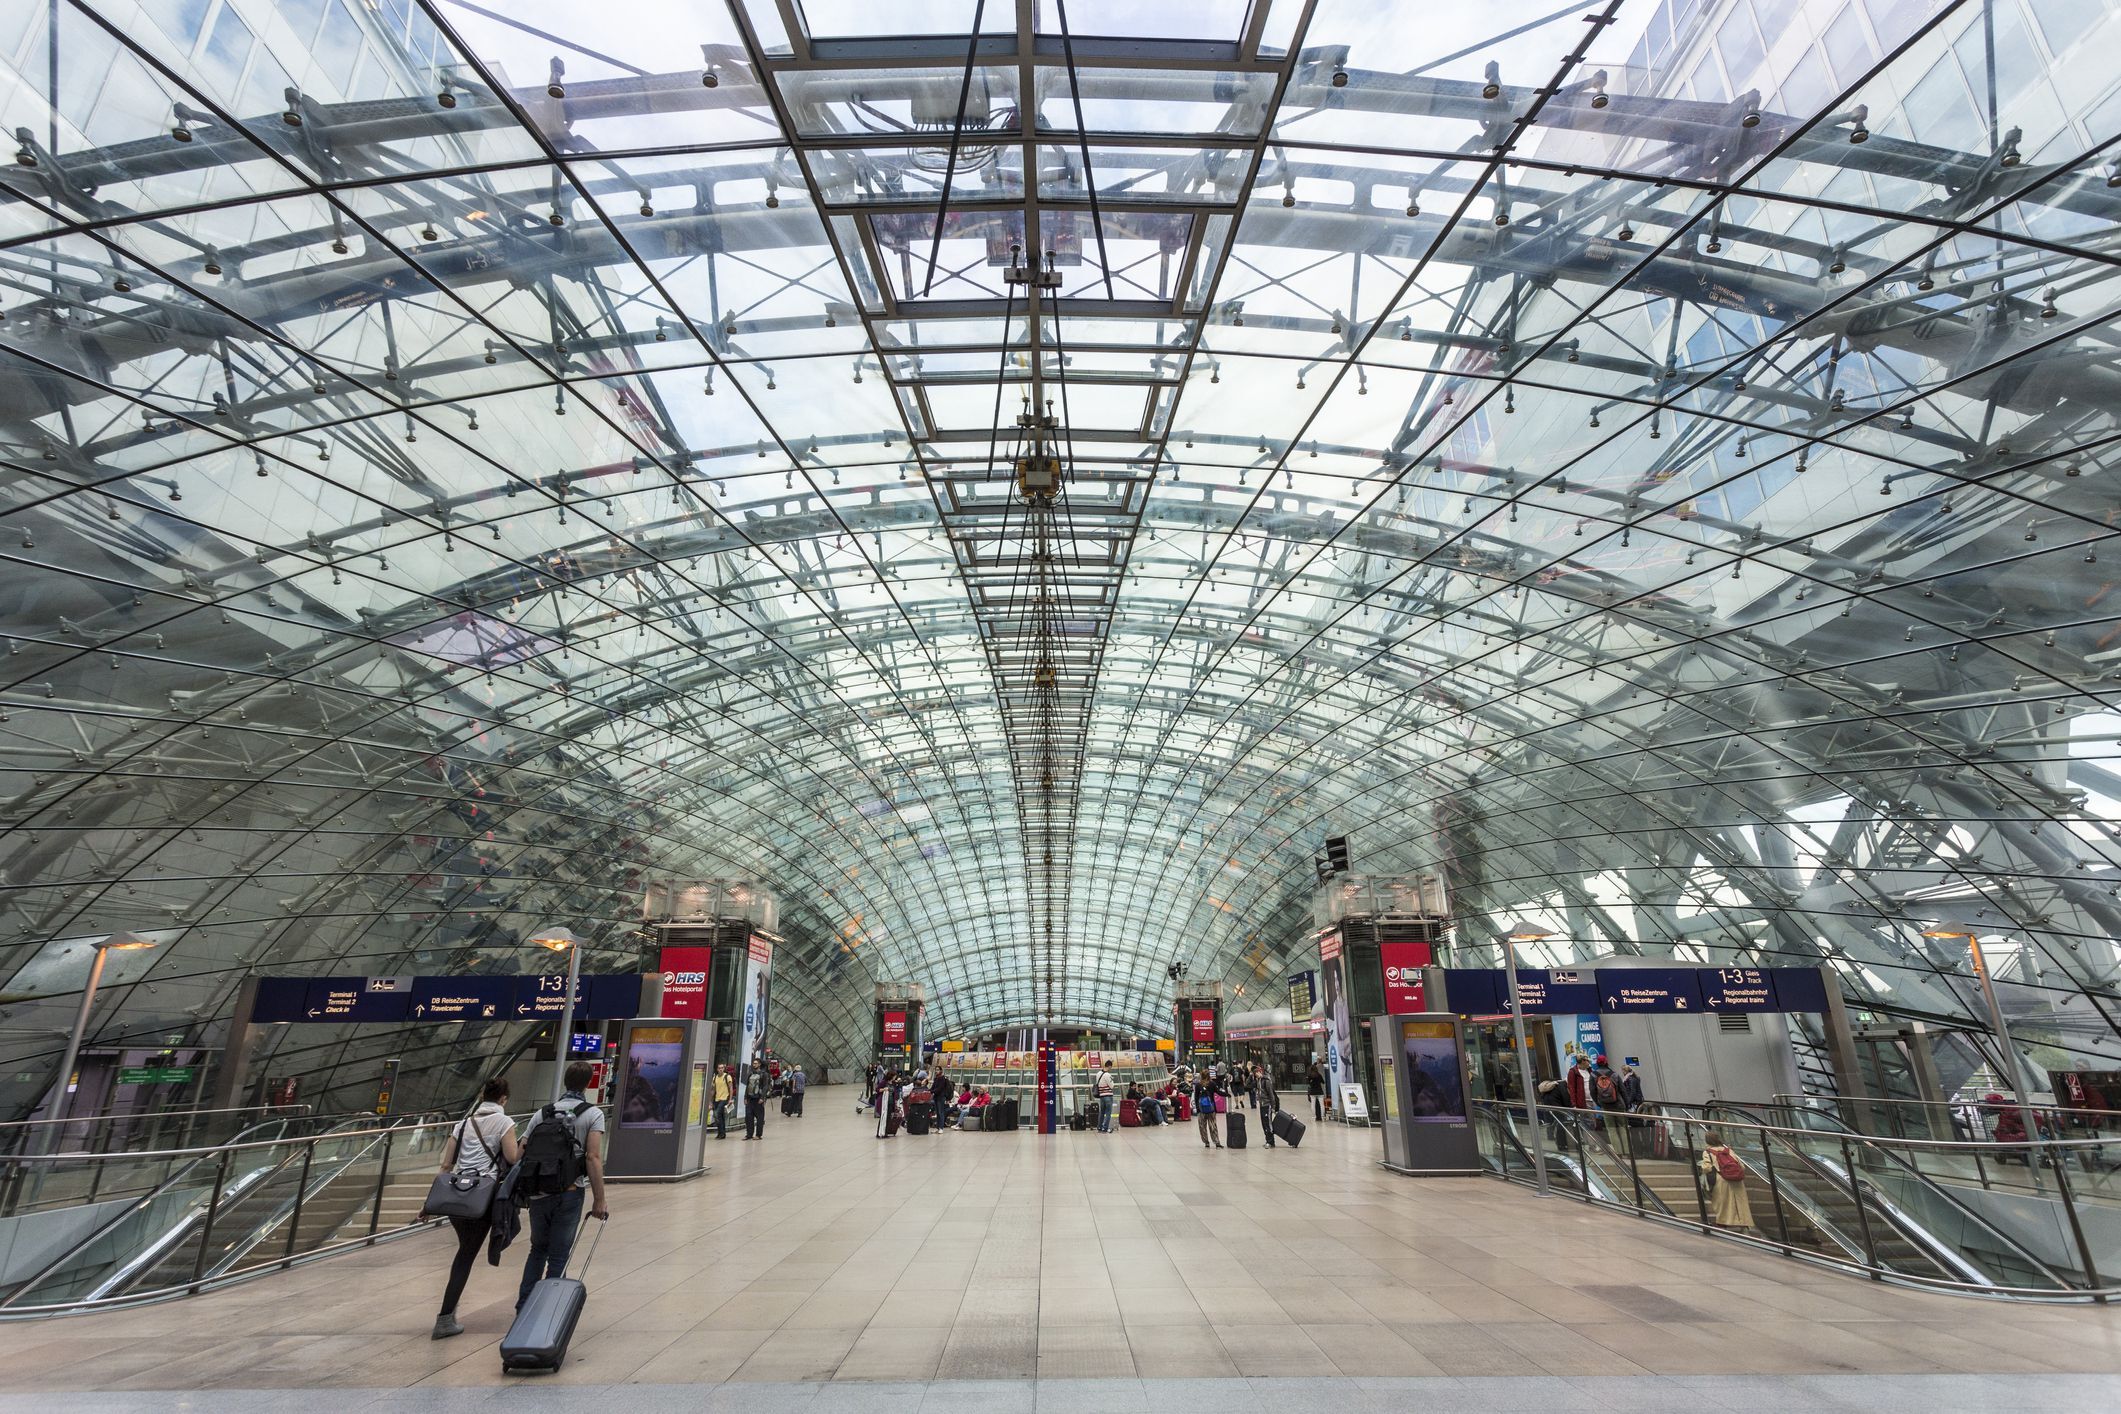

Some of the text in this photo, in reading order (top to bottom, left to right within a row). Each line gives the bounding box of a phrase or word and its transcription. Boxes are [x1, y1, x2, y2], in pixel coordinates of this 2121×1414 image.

[675, 972, 706, 984] HRS
[1718, 969, 1744, 984] 1-3
[538, 975, 563, 991] 1-3
[1723, 989, 1768, 997] Regionalbahnhof
[534, 1003, 559, 1011] Regional
[1579, 1022, 1600, 1031] CHANGE
[1581, 1034, 1602, 1043] CAMBIO
